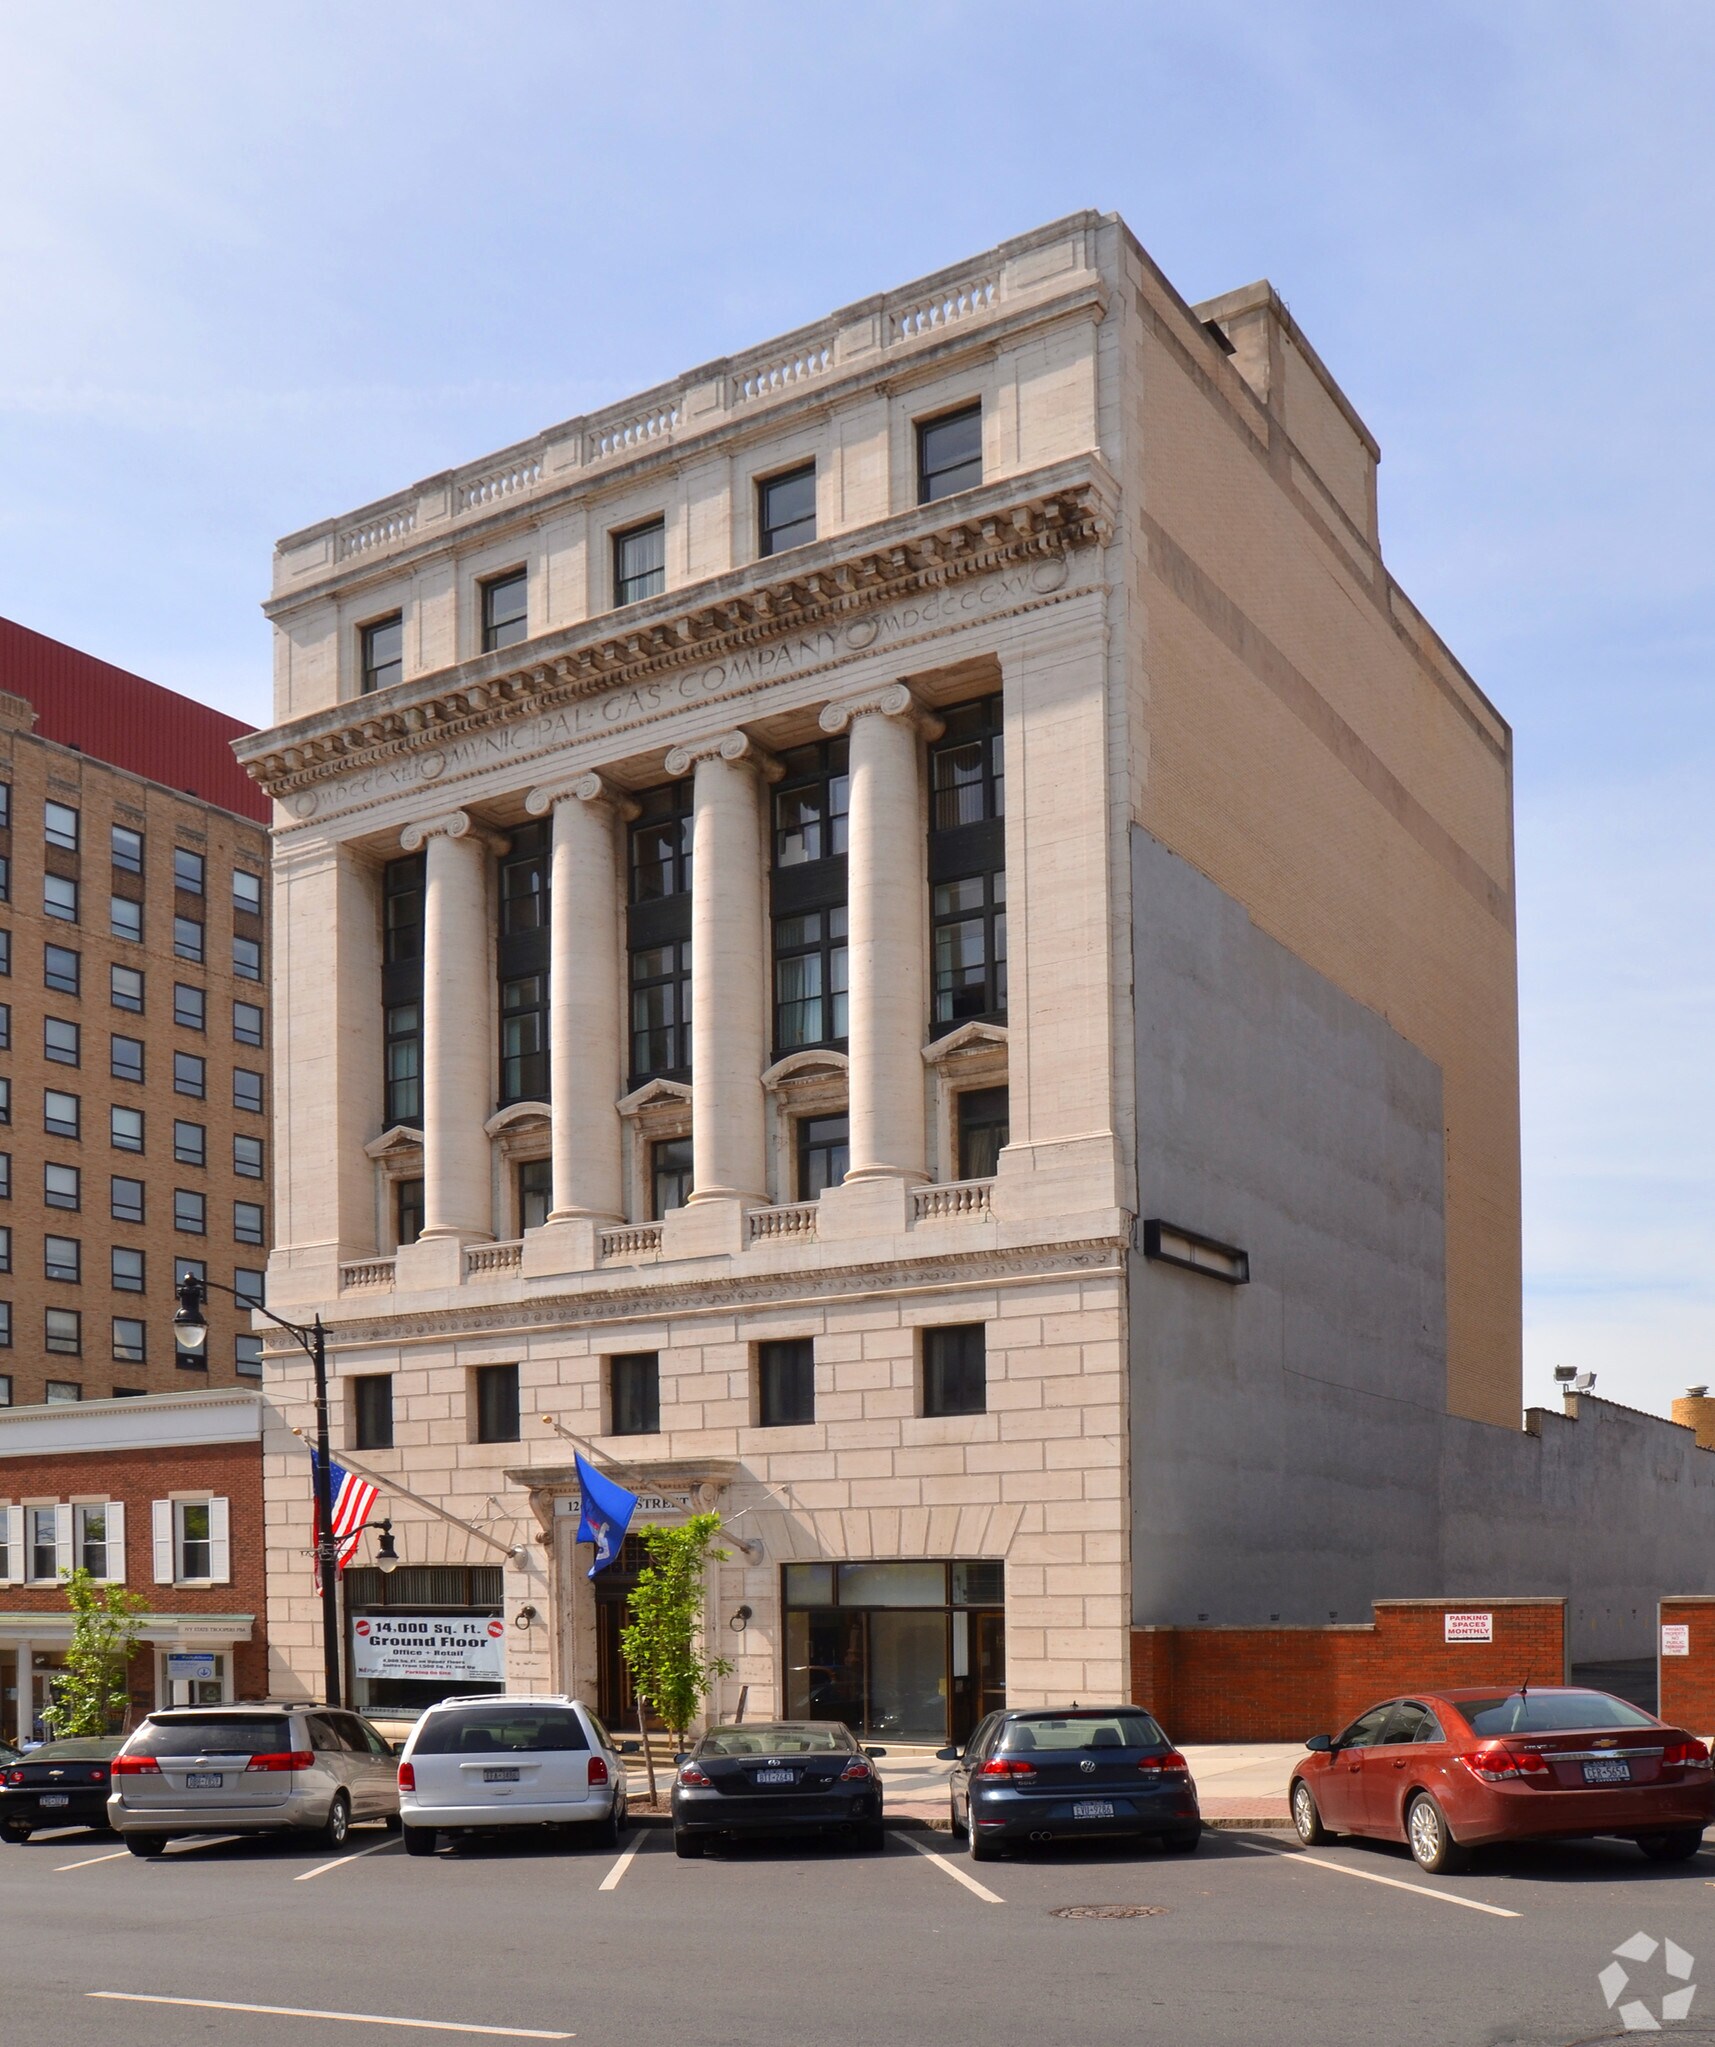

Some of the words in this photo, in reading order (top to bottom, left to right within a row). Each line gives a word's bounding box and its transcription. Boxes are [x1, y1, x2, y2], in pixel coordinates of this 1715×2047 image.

[602, 684, 662, 721] GAS
[679, 627, 843, 698] COMPANY
[375, 1622, 428, 1634] 14,000
[434, 1624, 457, 1635] Sq.
[463, 1624, 482, 1634] Ft.
[369, 1636, 436, 1647] Ground
[441, 1637, 488, 1648] Floor
